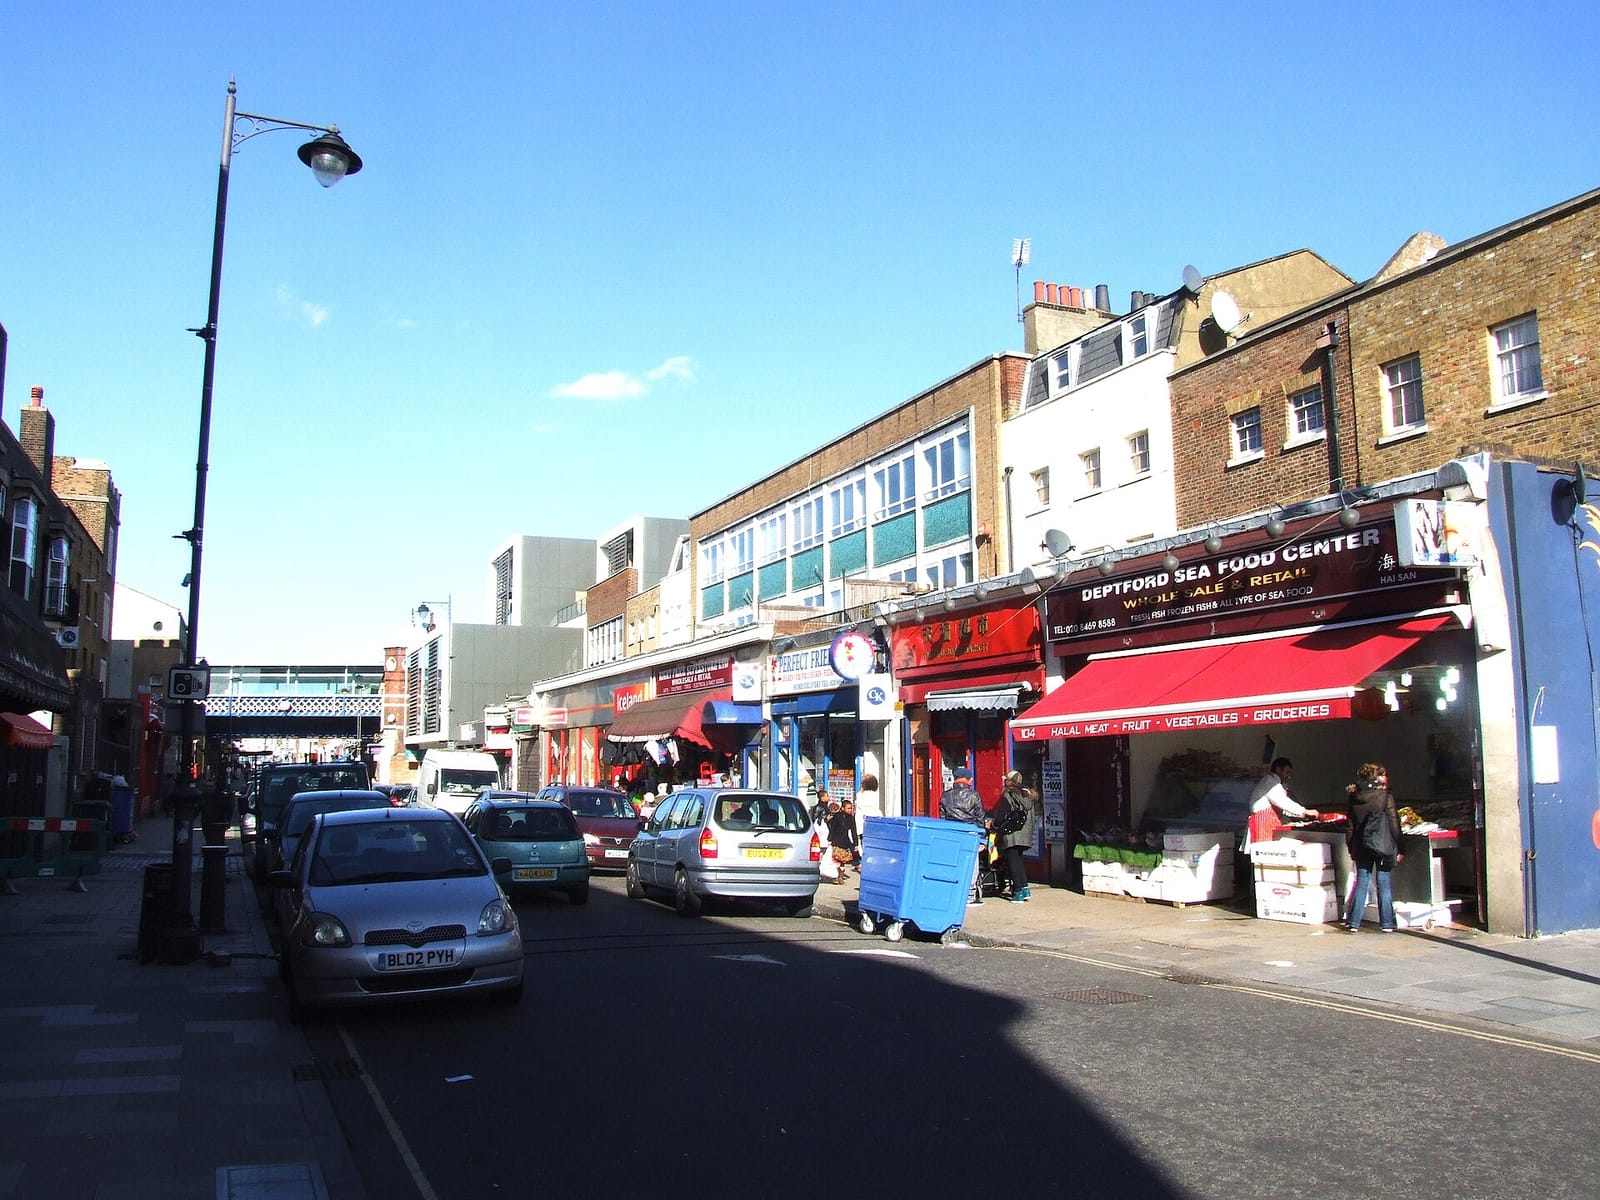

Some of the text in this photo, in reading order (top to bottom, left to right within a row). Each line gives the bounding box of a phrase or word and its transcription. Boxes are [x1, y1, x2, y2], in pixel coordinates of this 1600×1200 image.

[1081, 528, 1380, 602] DEPTFORD SEA FOOD CENTER
[1123, 591, 1179, 609] WHOLE
[1185, 582, 1224, 598] SALE
[1250, 567, 1310, 587] RETAIL
[1380, 571, 1417, 584] HAI SAN
[1151, 610, 1166, 620] FISH
[1167, 605, 1195, 616] FROZEN
[1219, 600, 1233, 608] ALL
[1235, 595, 1254, 605] TYPE
[1254, 593, 1267, 602] OF
[1268, 589, 1284, 600] SEA
[1286, 585, 1313, 597] FOOD
[1080, 620, 1096, 631] 8469
[1098, 617, 1116, 629] 8588
[777, 652, 809, 673] PERFECT
[616, 689, 643, 712] Iceland
[1020, 704, 1330, 739] 104 HALAL MEAT FRUIT VEGETABLES GROCERIES
[387, 949, 454, 966] BL02 PYH
